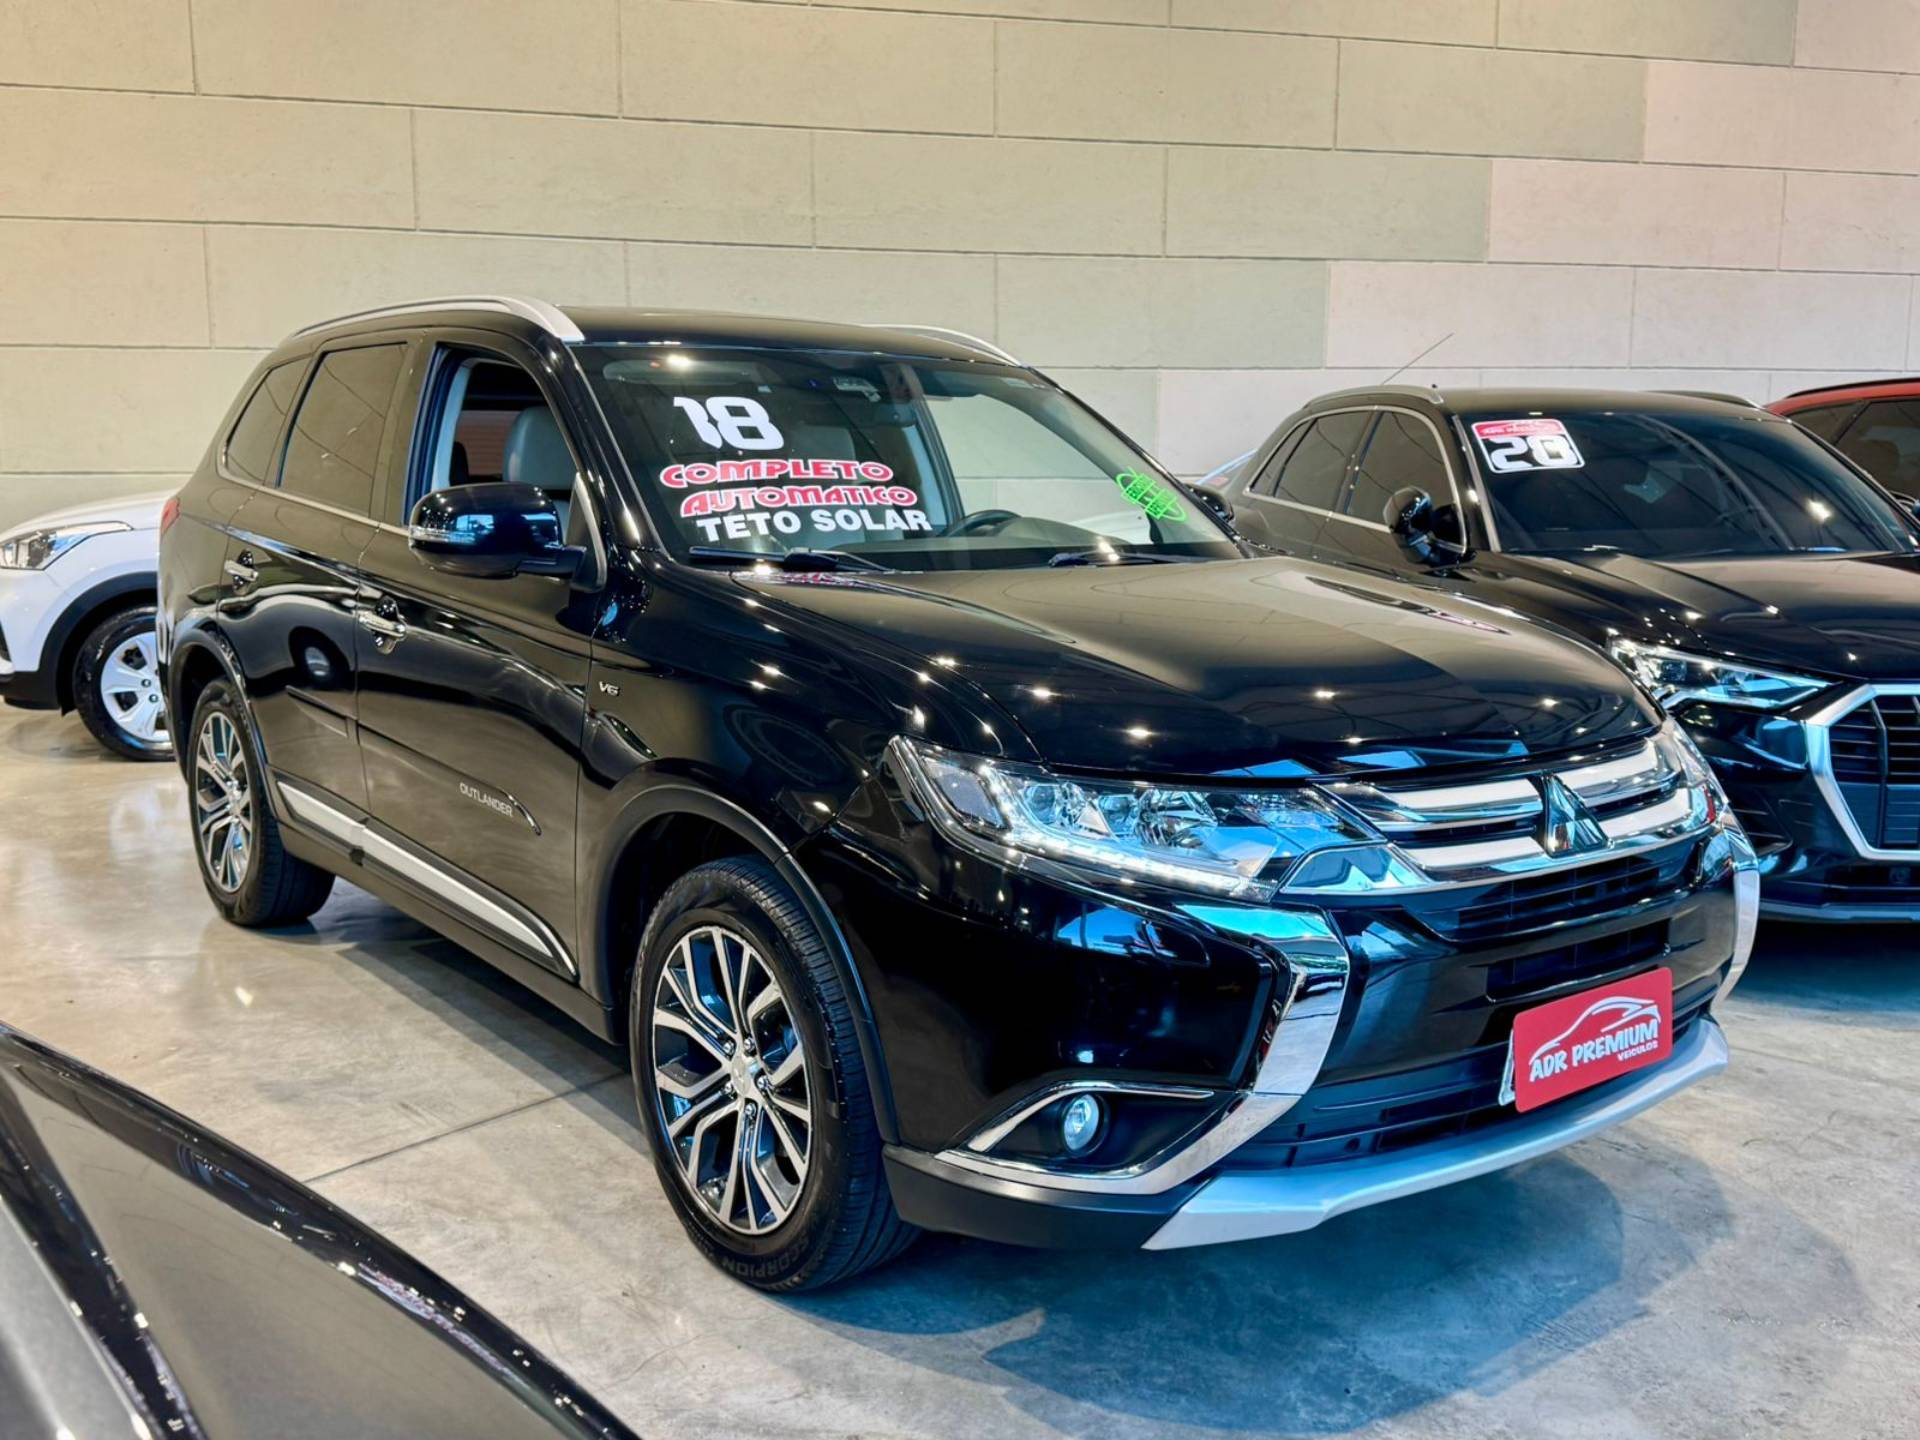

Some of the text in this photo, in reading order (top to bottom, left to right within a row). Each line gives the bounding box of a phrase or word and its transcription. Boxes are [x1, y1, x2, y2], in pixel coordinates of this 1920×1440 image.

[673, 396, 784, 450] 18
[659, 459, 894, 487] COMPLETO
[680, 485, 918, 518] AUTOMATICO
[696, 509, 932, 542] TETO SOLAR
[599, 681, 619, 696] V6
[460, 782, 513, 817] OUTLANDER
[1529, 1018, 1658, 1082] ADR PREMIUM
[1617, 1040, 1659, 1061] VEICULOS
